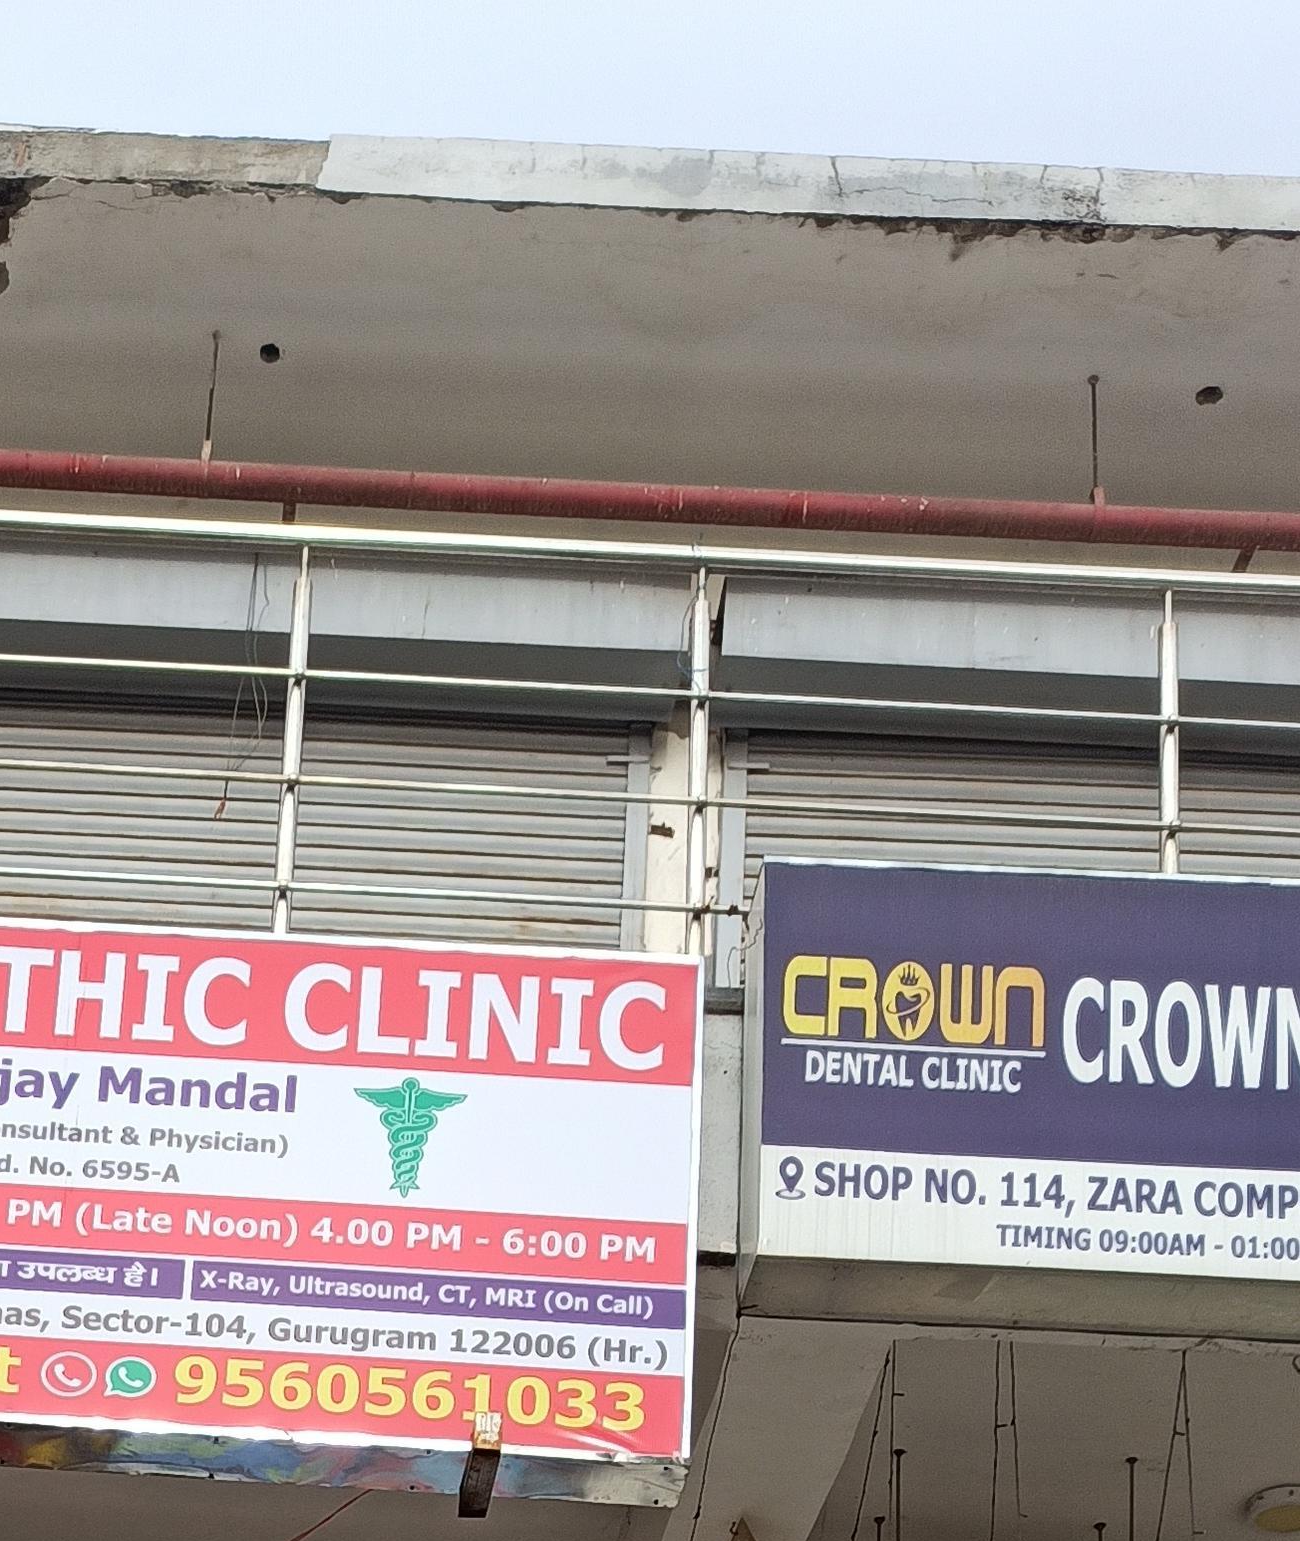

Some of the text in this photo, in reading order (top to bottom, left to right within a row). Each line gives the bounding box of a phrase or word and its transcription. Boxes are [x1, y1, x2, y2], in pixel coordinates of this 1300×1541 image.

[283, 962, 668, 1072] CLINIC
[99, 1065, 299, 1113] Mandal
[804, 1049, 1023, 1093] DENTAL CLINIC
[148, 1126, 290, 1160] Physician)
[28, 1154, 73, 1178] No.
[81, 1158, 182, 1185] 6595-A
[814, 1161, 1184, 1218] SHOP NO. 114, ZARA
[5, 1199, 63, 1230] PM
[74, 1197, 174, 1238] (Late
[184, 1206, 300, 1249] Noon)
[309, 1214, 395, 1248] 4.00
[404, 1219, 463, 1253] PM
[500, 1227, 588, 1258] 6:00
[598, 1232, 657, 1264] PM
[995, 1223, 1206, 1258] TIMING 09:00AM
[16, 1256, 117, 1289] उपलब्ध
[198, 1267, 655, 1319] X-Ray, Ultrasound, CT, MRI (On Call)
[60, 1304, 257, 1345] Sector-104,
[267, 1316, 438, 1355] Gurugram
[449, 1327, 578, 1362] 122006
[586, 1335, 670, 1371] (Hr.)
[173, 1354, 647, 1433] 9560561033
